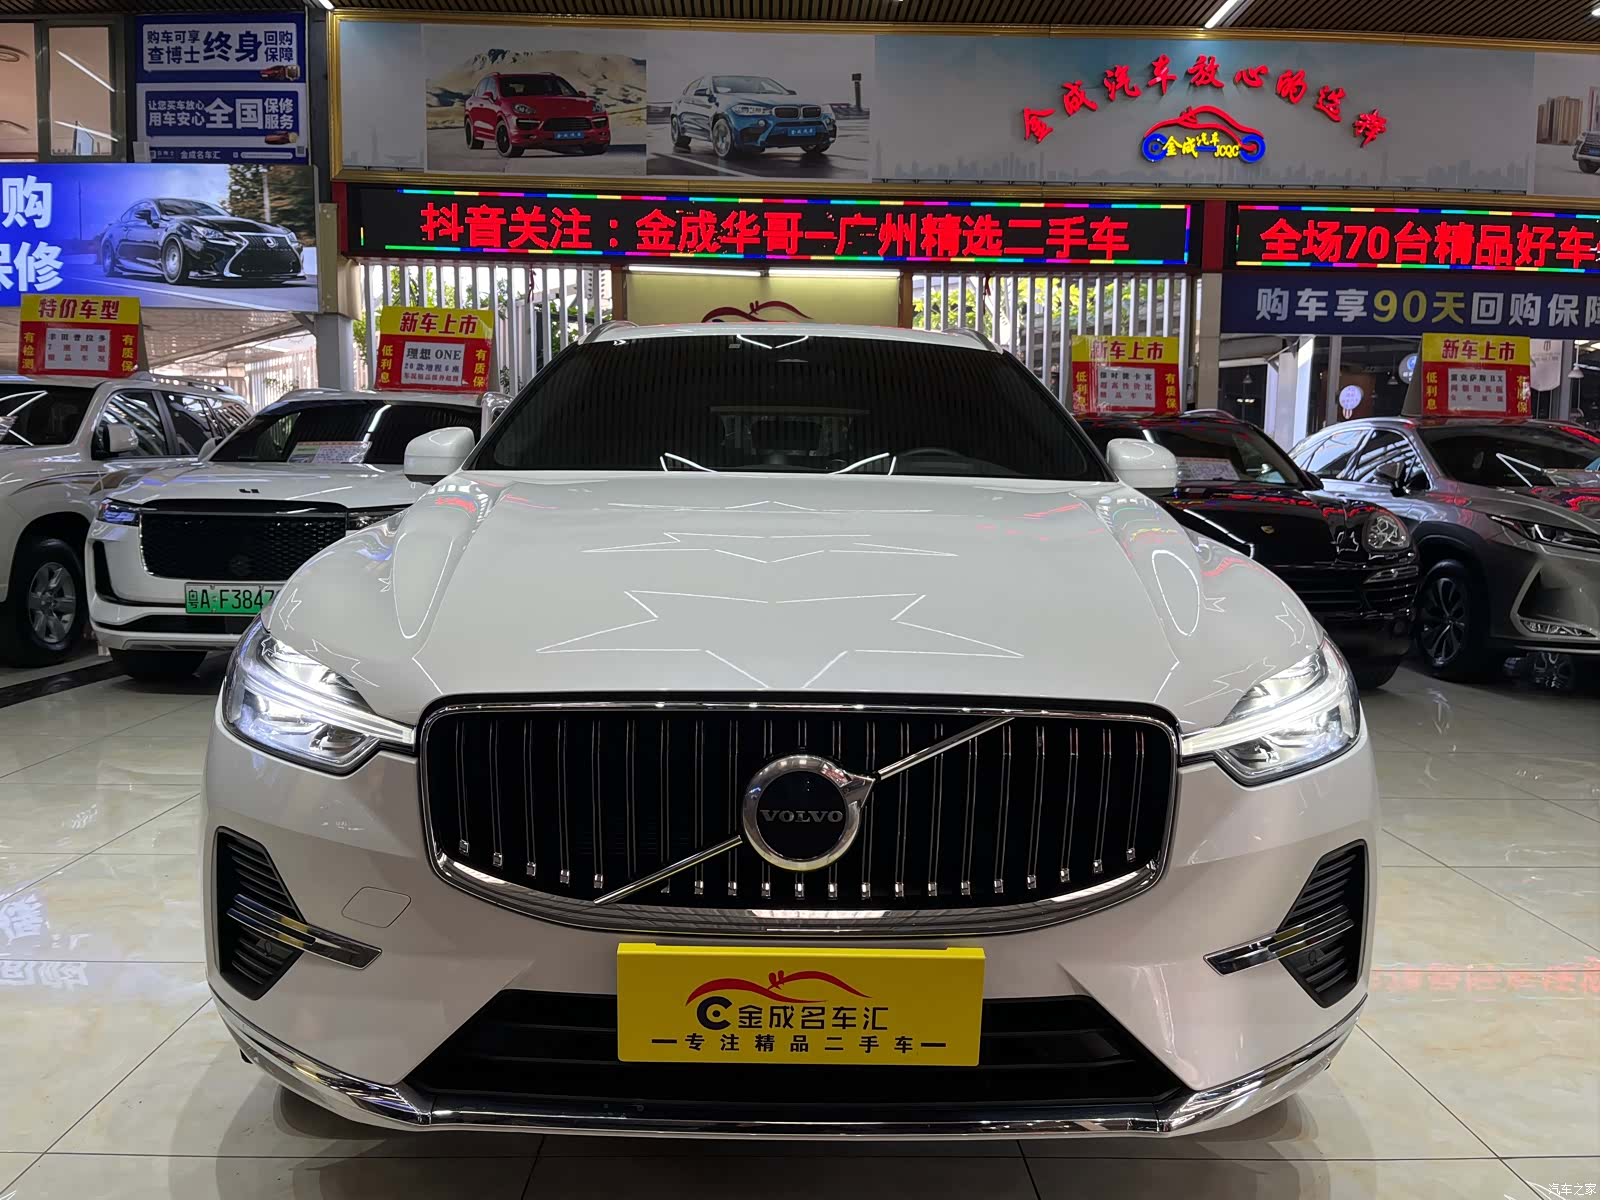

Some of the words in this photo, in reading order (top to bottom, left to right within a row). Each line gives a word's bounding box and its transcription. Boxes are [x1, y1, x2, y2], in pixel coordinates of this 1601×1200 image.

[147, 30, 200, 44] 购车可享
[203, 31, 263, 62] 终身
[264, 30, 293, 46] 回购
[147, 46, 200, 64] 查博士
[264, 47, 294, 63] 保障
[148, 100, 205, 111] 让您买车放心
[204, 97, 264, 130] 全国
[264, 98, 294, 114] 保修
[149, 112, 205, 127] 用车安心
[264, 114, 294, 130] 服务
[180, 150, 221, 160] 金成名车汇
[1214, 144, 1239, 158] JCQC
[2, 175, 53, 229] 购
[1259, 218, 1596, 269] 全场70台精品好车
[38, 298, 120, 320] 特价车型
[399, 311, 479, 335] 新车上市
[21, 332, 36, 370] 有检测
[121, 334, 136, 372] 有质保
[406, 347, 431, 361] 理想
[434, 349, 462, 361] ONE
[1090, 340, 1165, 361] 新车上市
[1441, 339, 1516, 361] 新车上市
[380, 345, 394, 384] 低利息
[473, 349, 488, 388] 有质保
[1164, 373, 1177, 409] 有质保
[1426, 371, 1438, 410] 低利息
[759, 809, 844, 823] VOLVO
[738, 1004, 889, 1030] 金成名车汇
[685, 1032, 914, 1054] 专注精品二手车
